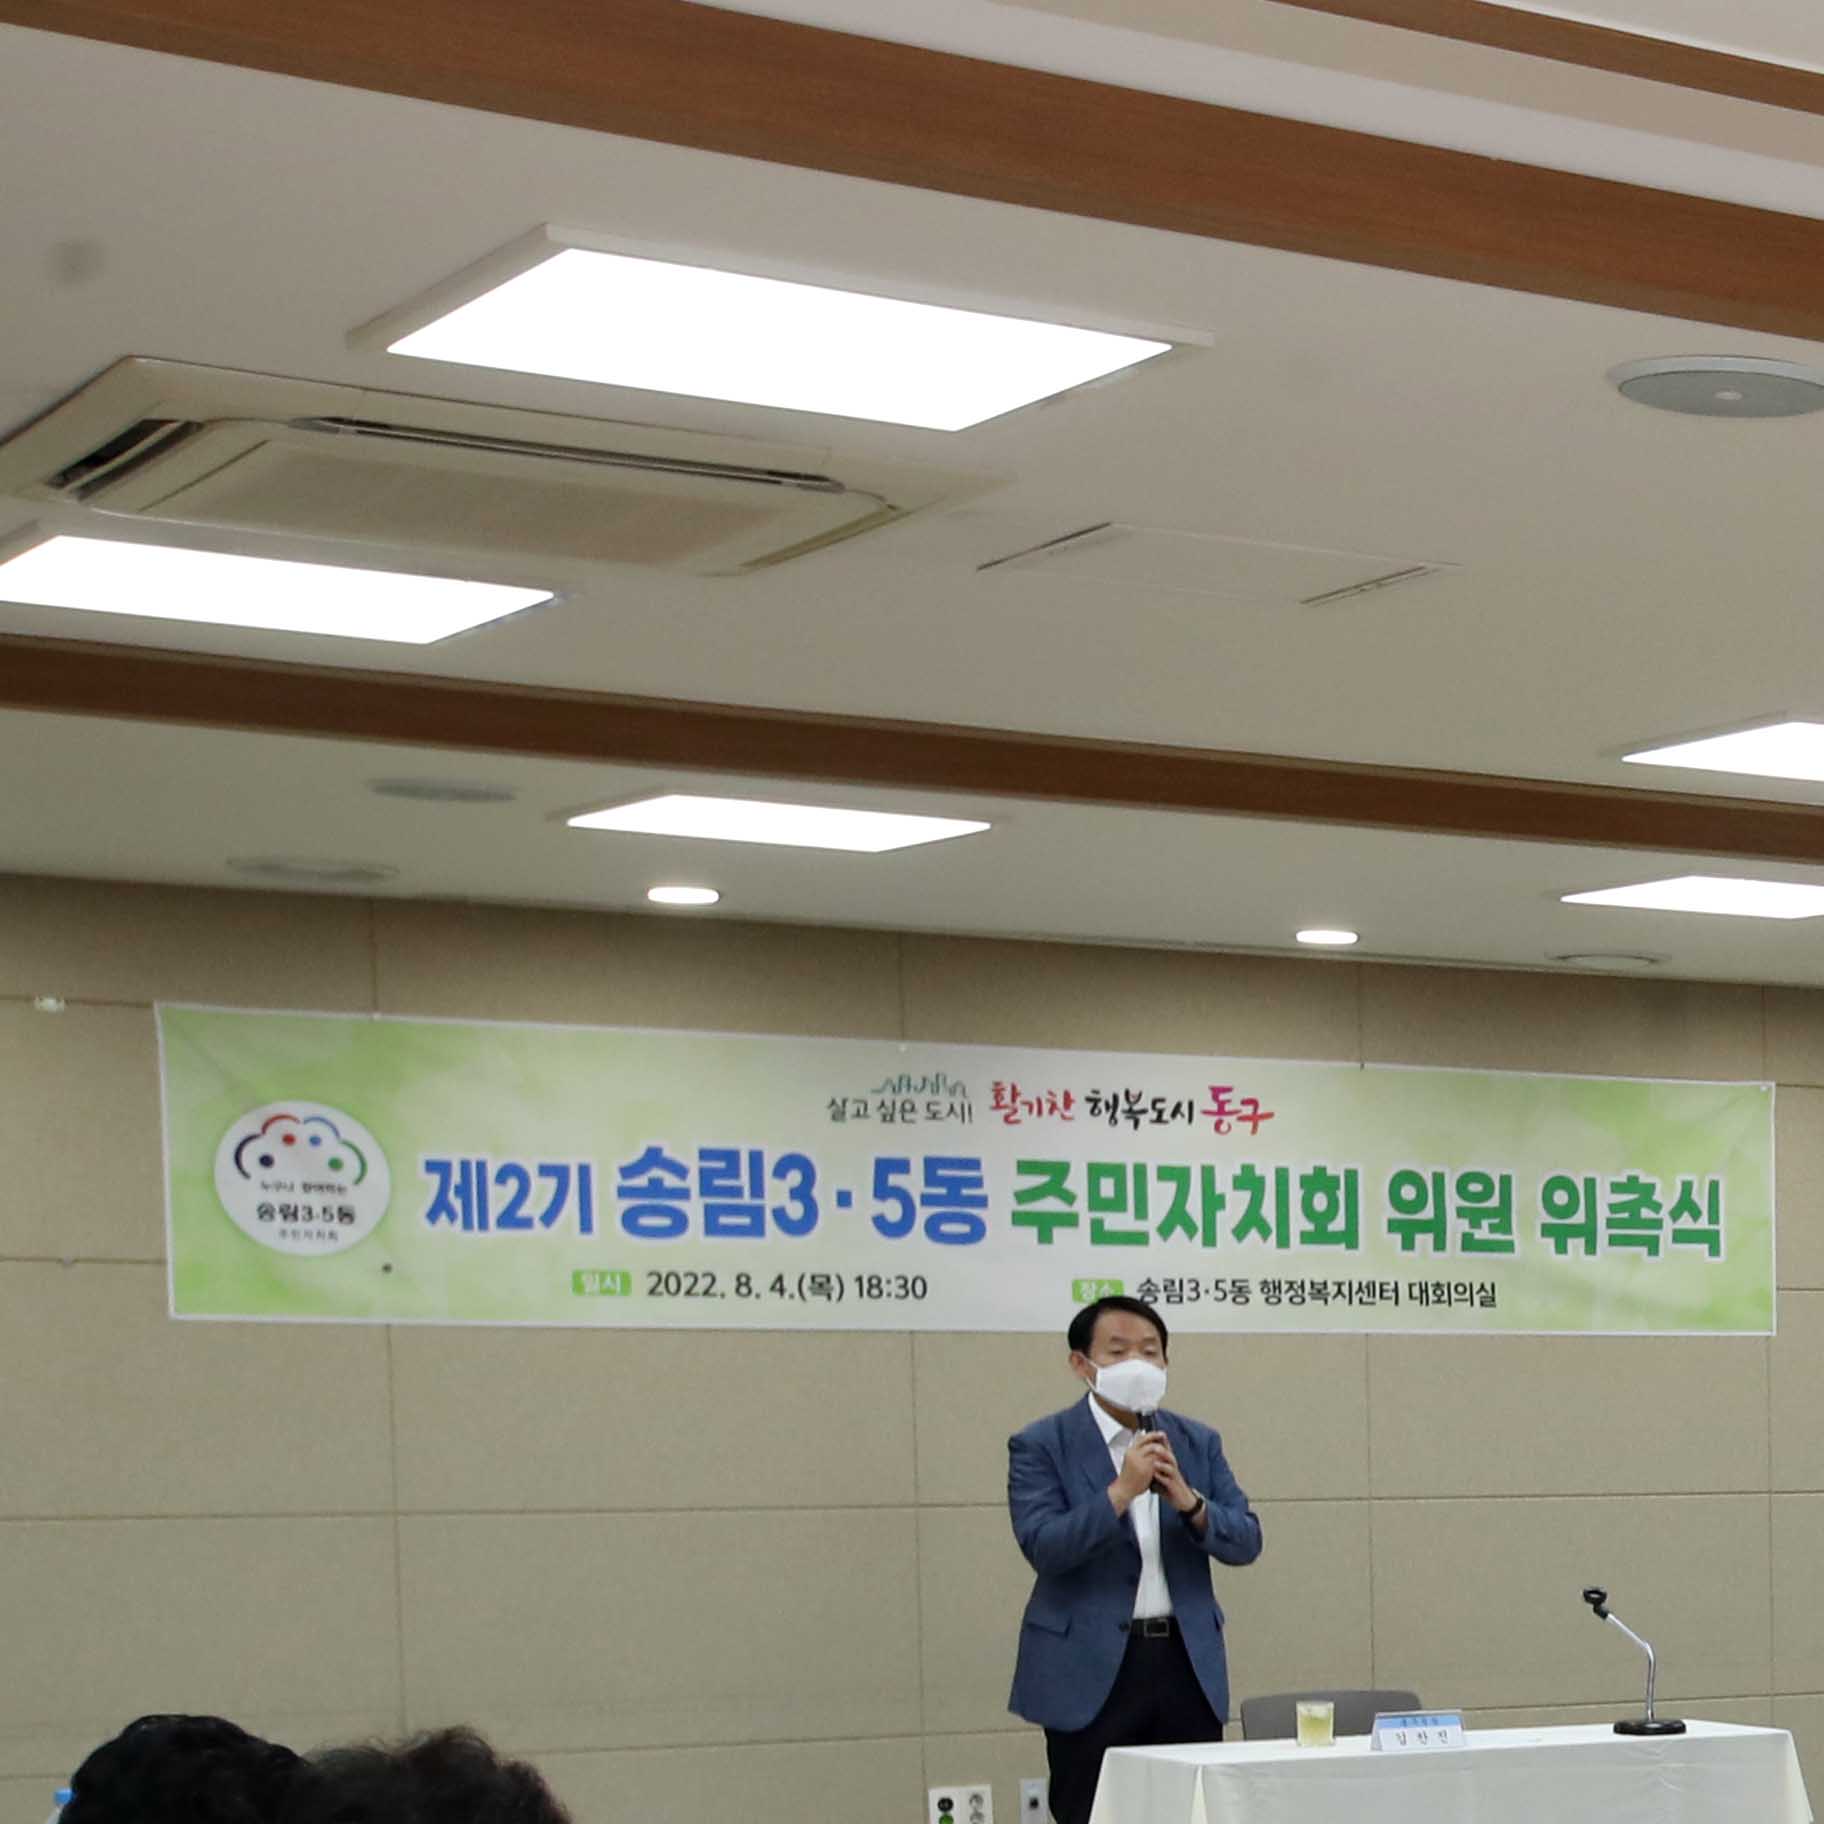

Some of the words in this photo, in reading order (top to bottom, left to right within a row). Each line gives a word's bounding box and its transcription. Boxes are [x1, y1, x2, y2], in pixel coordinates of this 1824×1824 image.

[827, 1097, 871, 1124] 살고
[876, 1098, 918, 1125] 싶은
[924, 1101, 973, 1124] 도시!
[989, 1081, 1076, 1125] 활기찬
[1084, 1088, 1194, 1131] 행복도시
[1201, 1085, 1275, 1136] 동구
[424, 1158, 594, 1236] 제2기
[1011, 1159, 1360, 1251] 주민자치회
[1387, 1169, 1516, 1254] 위원
[1540, 1174, 1721, 1257] 위촉식
[646, 1270, 727, 1299] 2022.
[734, 1273, 761, 1299] 8.
[853, 1275, 929, 1300] 18:30
[1259, 1279, 1400, 1307] 행정복지센터
[1407, 1280, 1498, 1309] 대회의실
